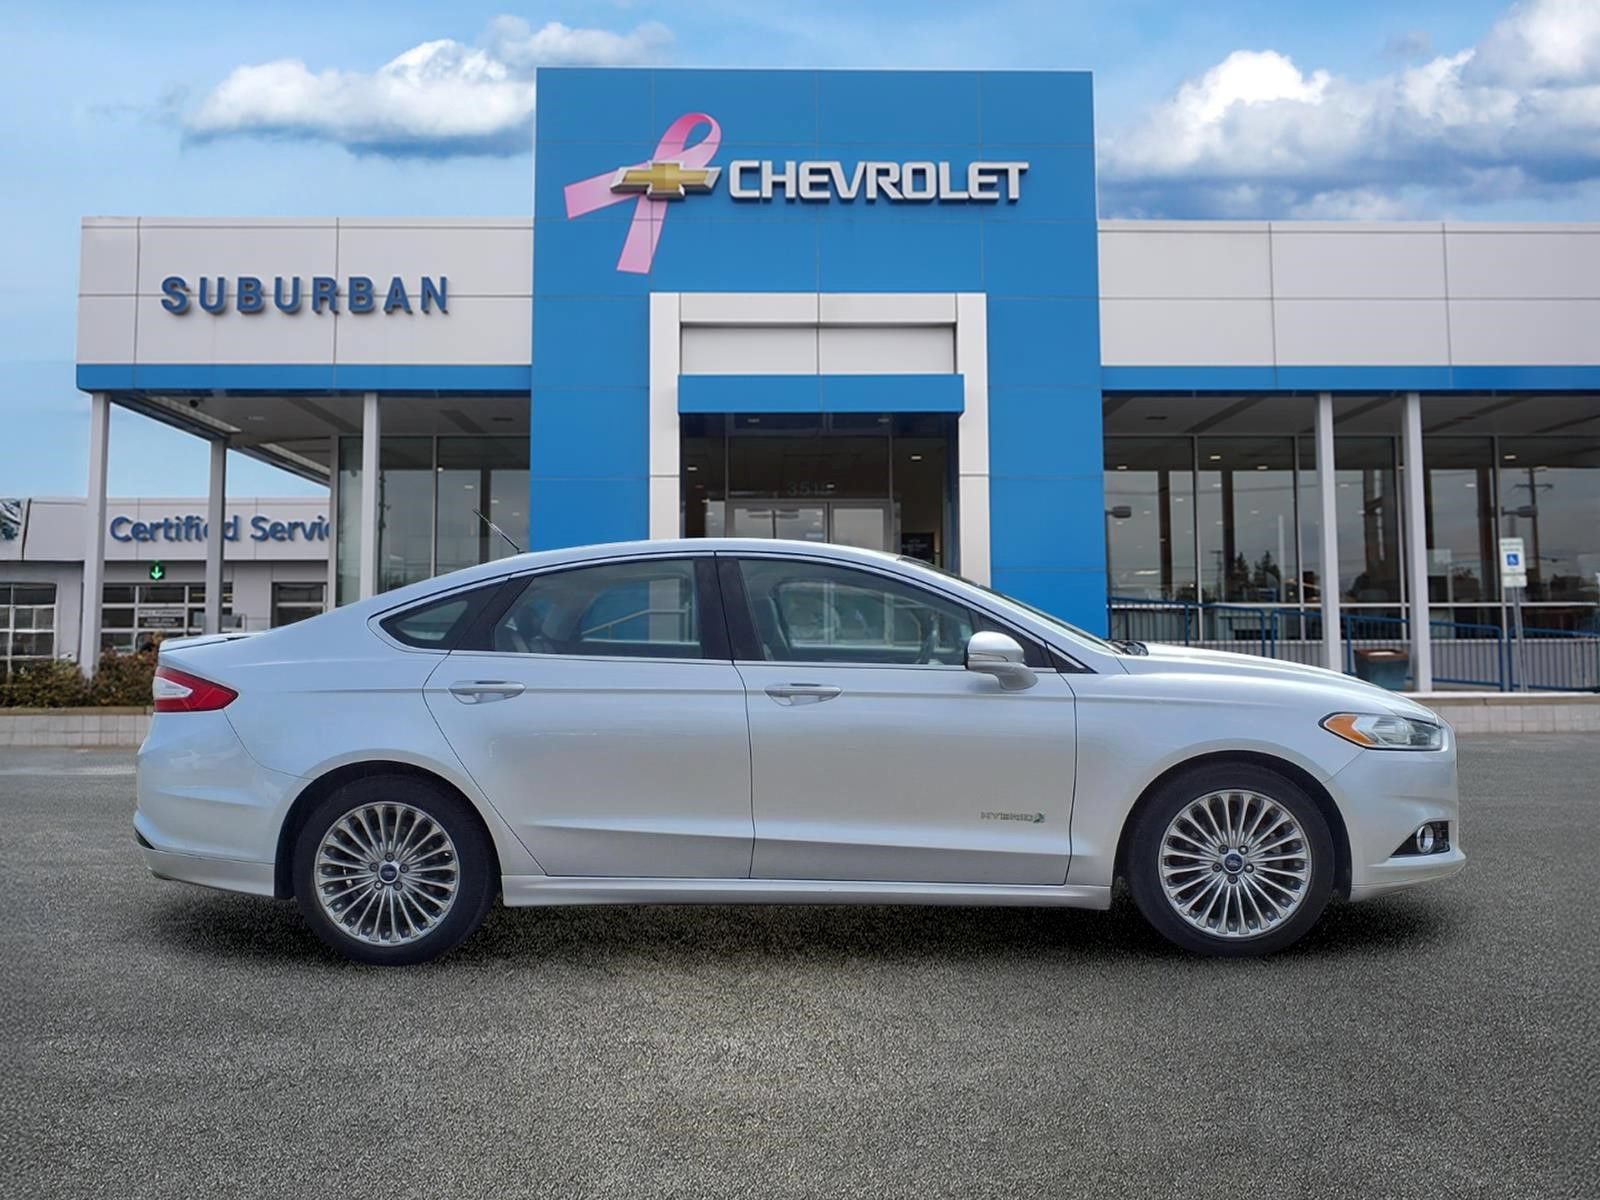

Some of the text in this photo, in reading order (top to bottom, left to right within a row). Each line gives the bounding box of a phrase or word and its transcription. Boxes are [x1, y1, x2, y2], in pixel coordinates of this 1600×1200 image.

[729, 160, 1029, 202] CHEVROLET
[161, 276, 449, 315] SUBURBAN
[981, 811, 1034, 822] HYBRID
